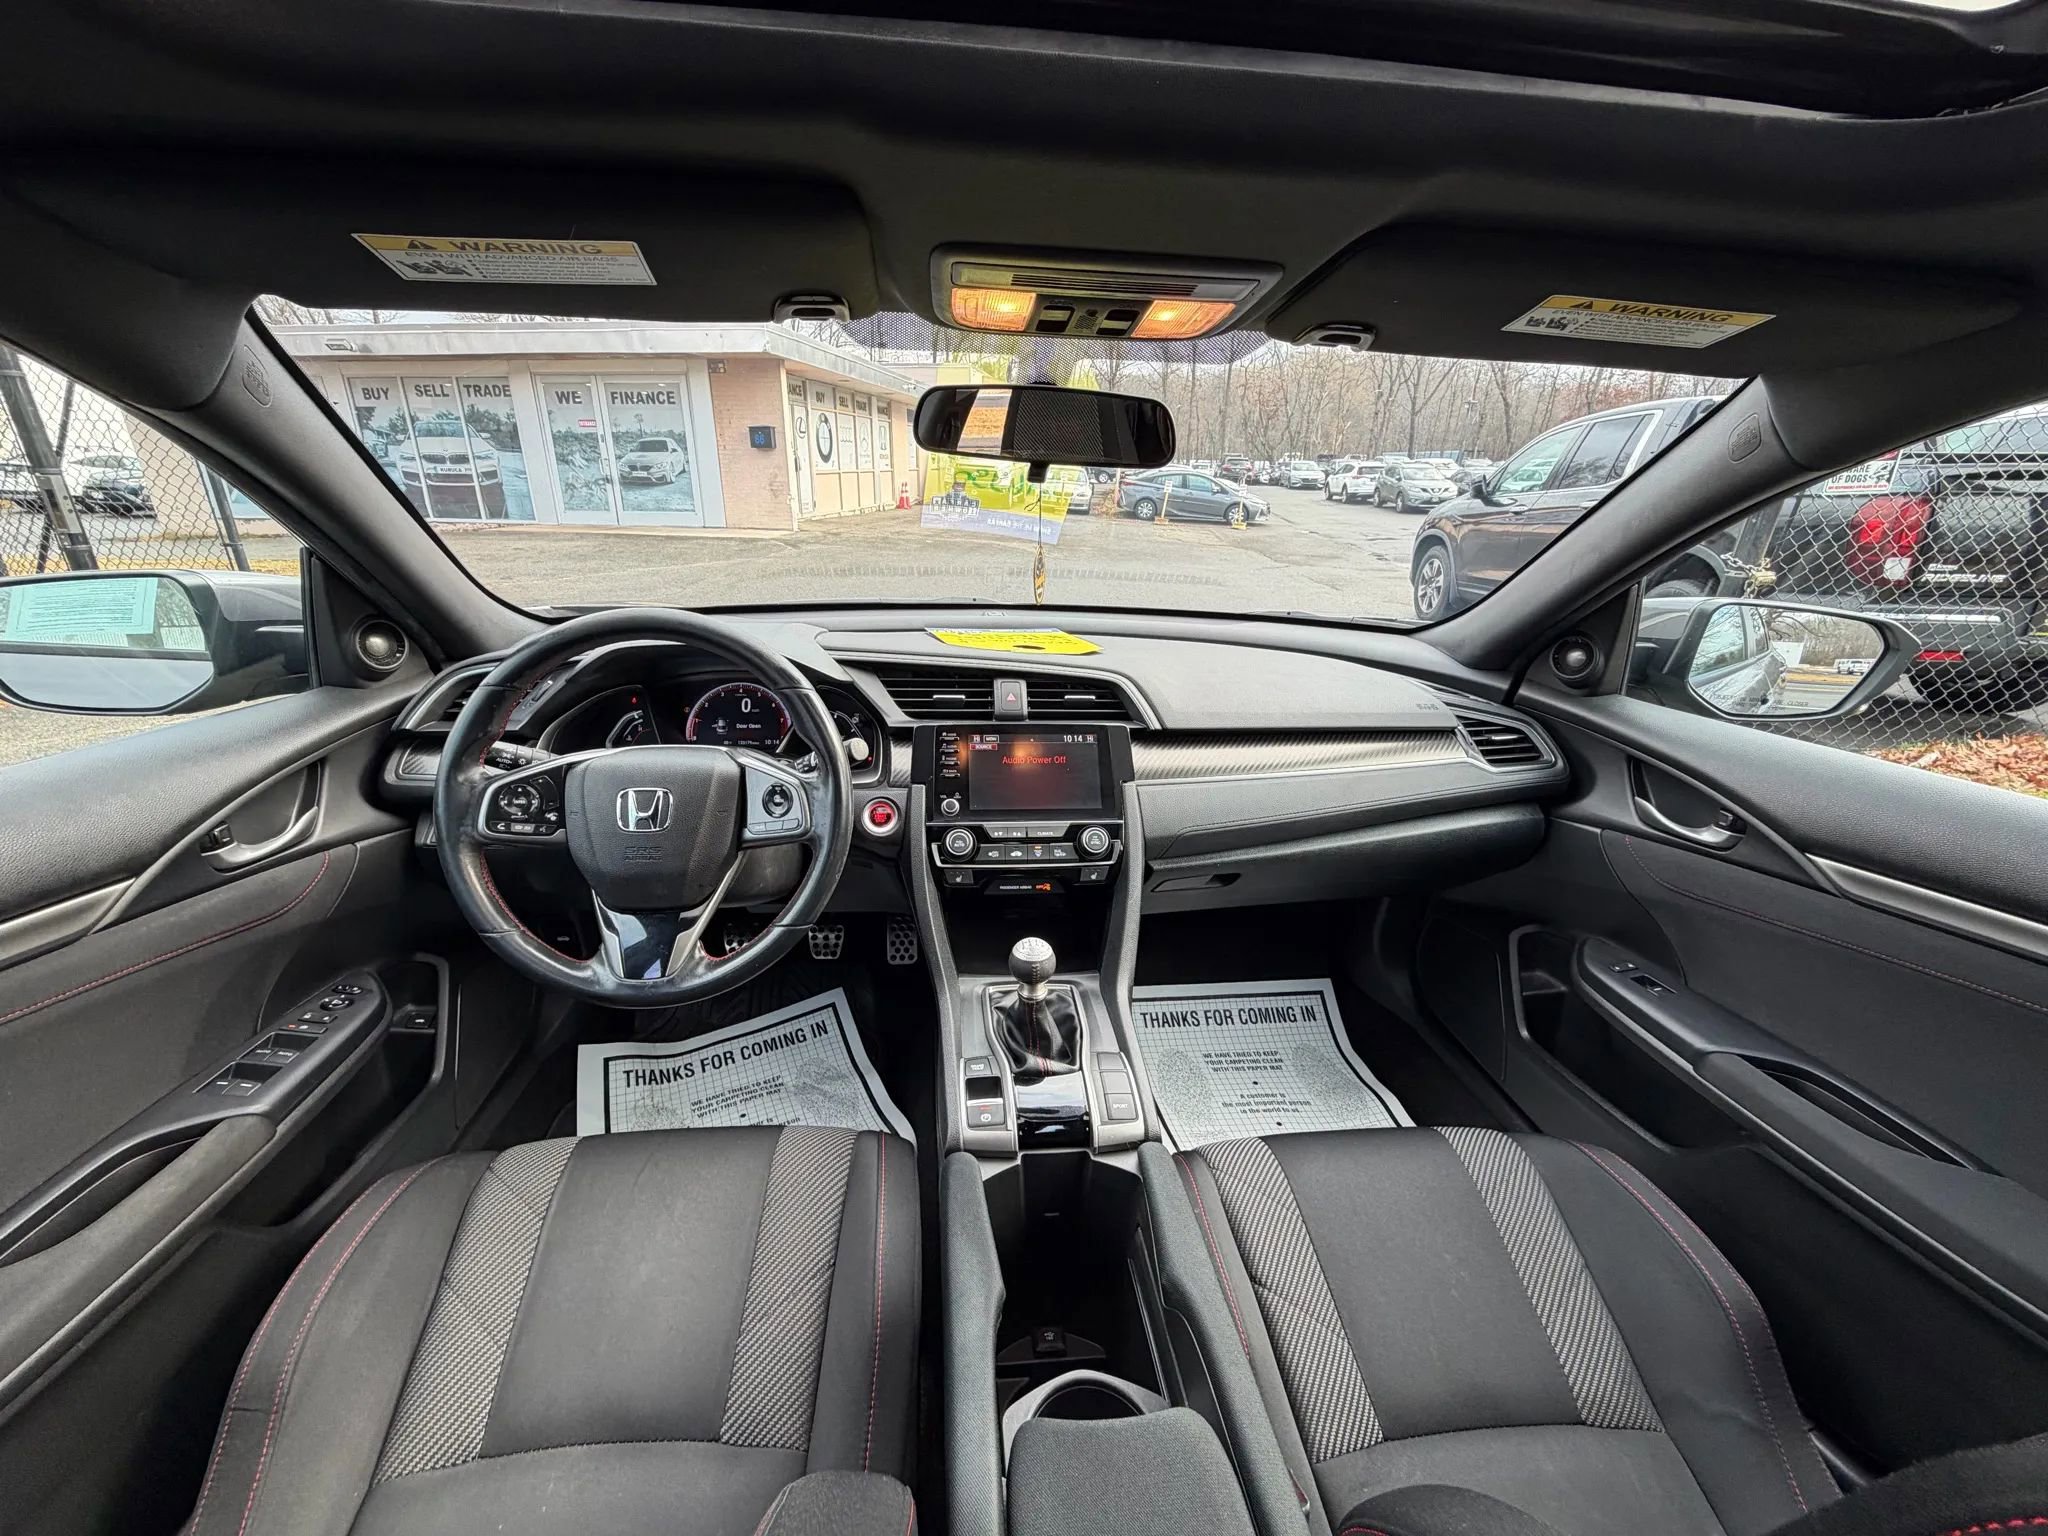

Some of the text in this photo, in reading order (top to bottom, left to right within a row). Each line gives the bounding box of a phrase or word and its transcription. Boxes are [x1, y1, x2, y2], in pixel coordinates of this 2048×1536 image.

[448, 240, 603, 254] WARNING
[1609, 303, 1734, 322] WARNING
[362, 384, 512, 400] BUY SELL TRADE
[556, 390, 676, 405] WE FINANCE
[816, 392, 826, 403] BUY
[838, 396, 849, 408] SELL
[1844, 474, 1868, 483] DOGS
[741, 698, 751, 712] 0
[1002, 756, 1025, 764] Audio
[1054, 756, 1066, 764] Off
[1140, 1005, 1317, 1029] THANKS FOR COMING IN
[623, 1019, 829, 1088] THANKS FOR COMING IN
[691, 1100, 704, 1108] WE
[706, 1092, 726, 1102] HAVE
[728, 1085, 750, 1094] TRIED
[763, 1075, 781, 1084] KEEP
[692, 1082, 784, 1113] YOUR CARPETING CLEAN
[696, 1108, 718, 1118] WITH
[720, 1101, 737, 1110] THIS
[740, 1093, 764, 1104] PAPER
